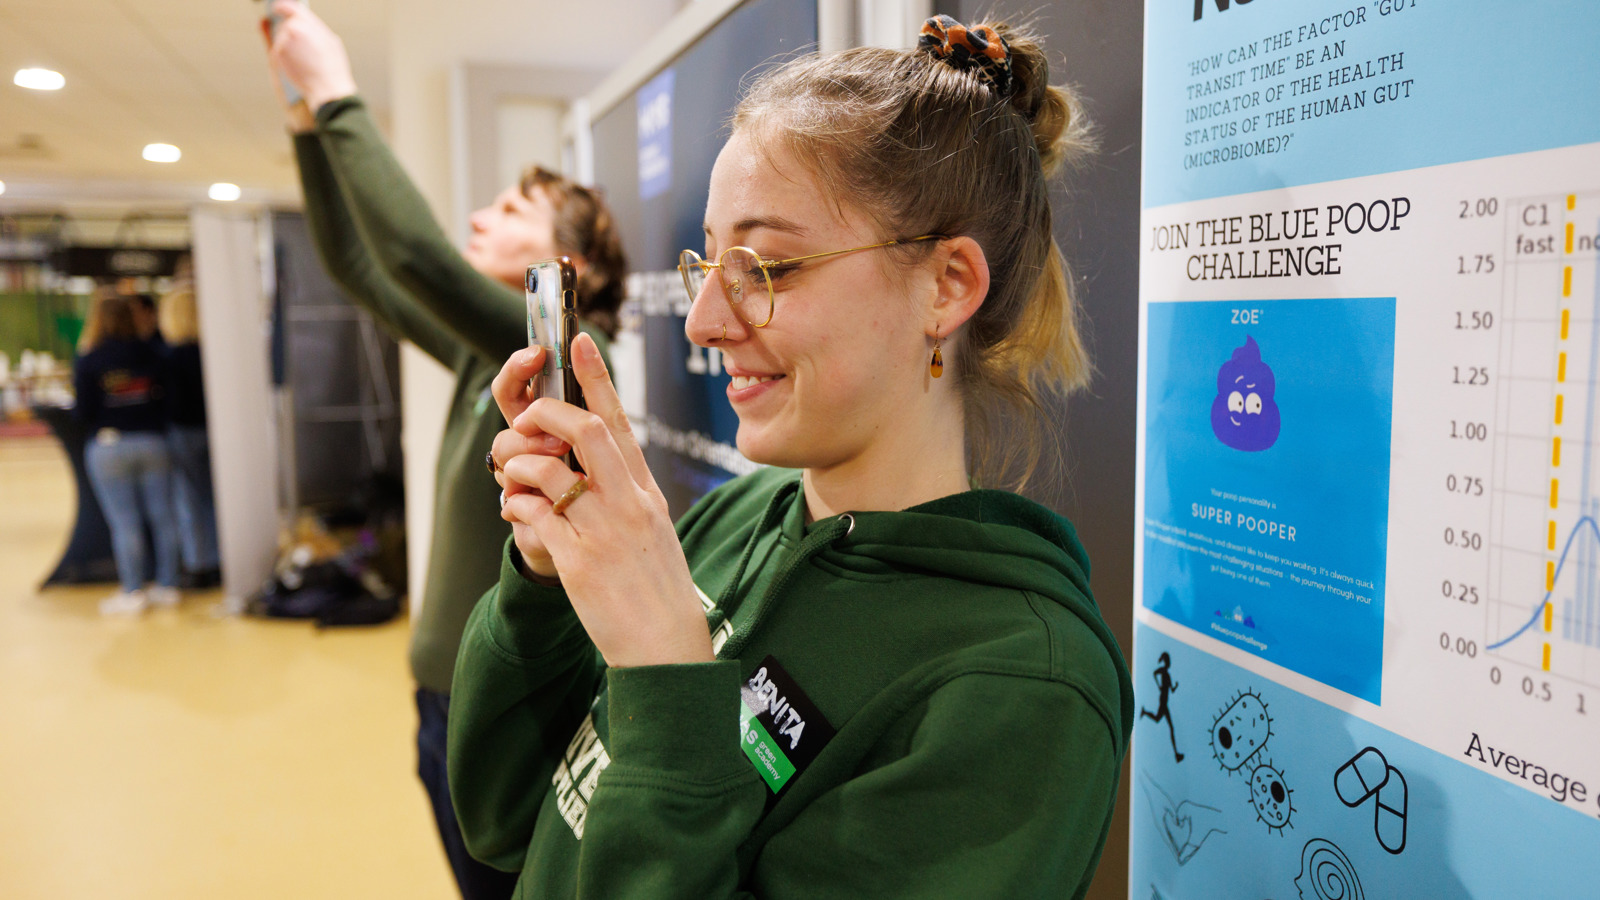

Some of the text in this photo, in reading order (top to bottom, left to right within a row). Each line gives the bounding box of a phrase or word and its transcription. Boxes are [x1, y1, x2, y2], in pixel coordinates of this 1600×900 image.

[1188, 53, 1222, 76] "HOW
[1228, 42, 1258, 64] CAN
[1263, 30, 1292, 53] THE
[1298, 6, 1366, 43] FACTOR
[1187, 40, 1346, 100] TRANSIT TIME" BE AN
[1186, 52, 1404, 124] INDICATOR OF THE HEALTH
[1184, 79, 1414, 146] STATUS OF THE HUMAN GUT
[1184, 133, 1294, 170] (MICROBIOME)?"
[1459, 198, 1498, 219] 2.00
[1522, 204, 1550, 226] C1
[1150, 197, 1411, 252] JOIN THE BLUE POOP
[1516, 234, 1555, 255] fast
[1186, 244, 1342, 281] CHALLENGE
[1457, 254, 1495, 275] 1.75
[1454, 311, 1493, 330] 1.50
[1452, 366, 1489, 386] 1.25
[1450, 420, 1487, 441] 1.00
[1223, 492, 1238, 502] poop
[1239, 496, 1271, 510] personality
[1447, 474, 1484, 497] 0.75
[1192, 503, 1297, 542] SUPER POOPER
[1444, 527, 1482, 551] 0.50
[1258, 550, 1264, 559] to
[1264, 552, 1280, 563] keep
[1281, 557, 1292, 566] you
[1320, 566, 1329, 577] It's
[1330, 571, 1354, 584] always
[1355, 579, 1375, 590] quick
[1290, 573, 1301, 583] the
[1301, 578, 1326, 592] journey
[1327, 585, 1354, 600] through
[1356, 594, 1372, 605] your
[1442, 581, 1479, 604] 0.25
[1440, 632, 1477, 659] 0.00
[1490, 666, 1587, 715] 0 0.5 1
[748, 666, 805, 750] BENITA
[739, 715, 758, 745] AS
[755, 747, 780, 780] academy
[759, 741, 776, 763] green
[1463, 732, 1588, 802] Average
